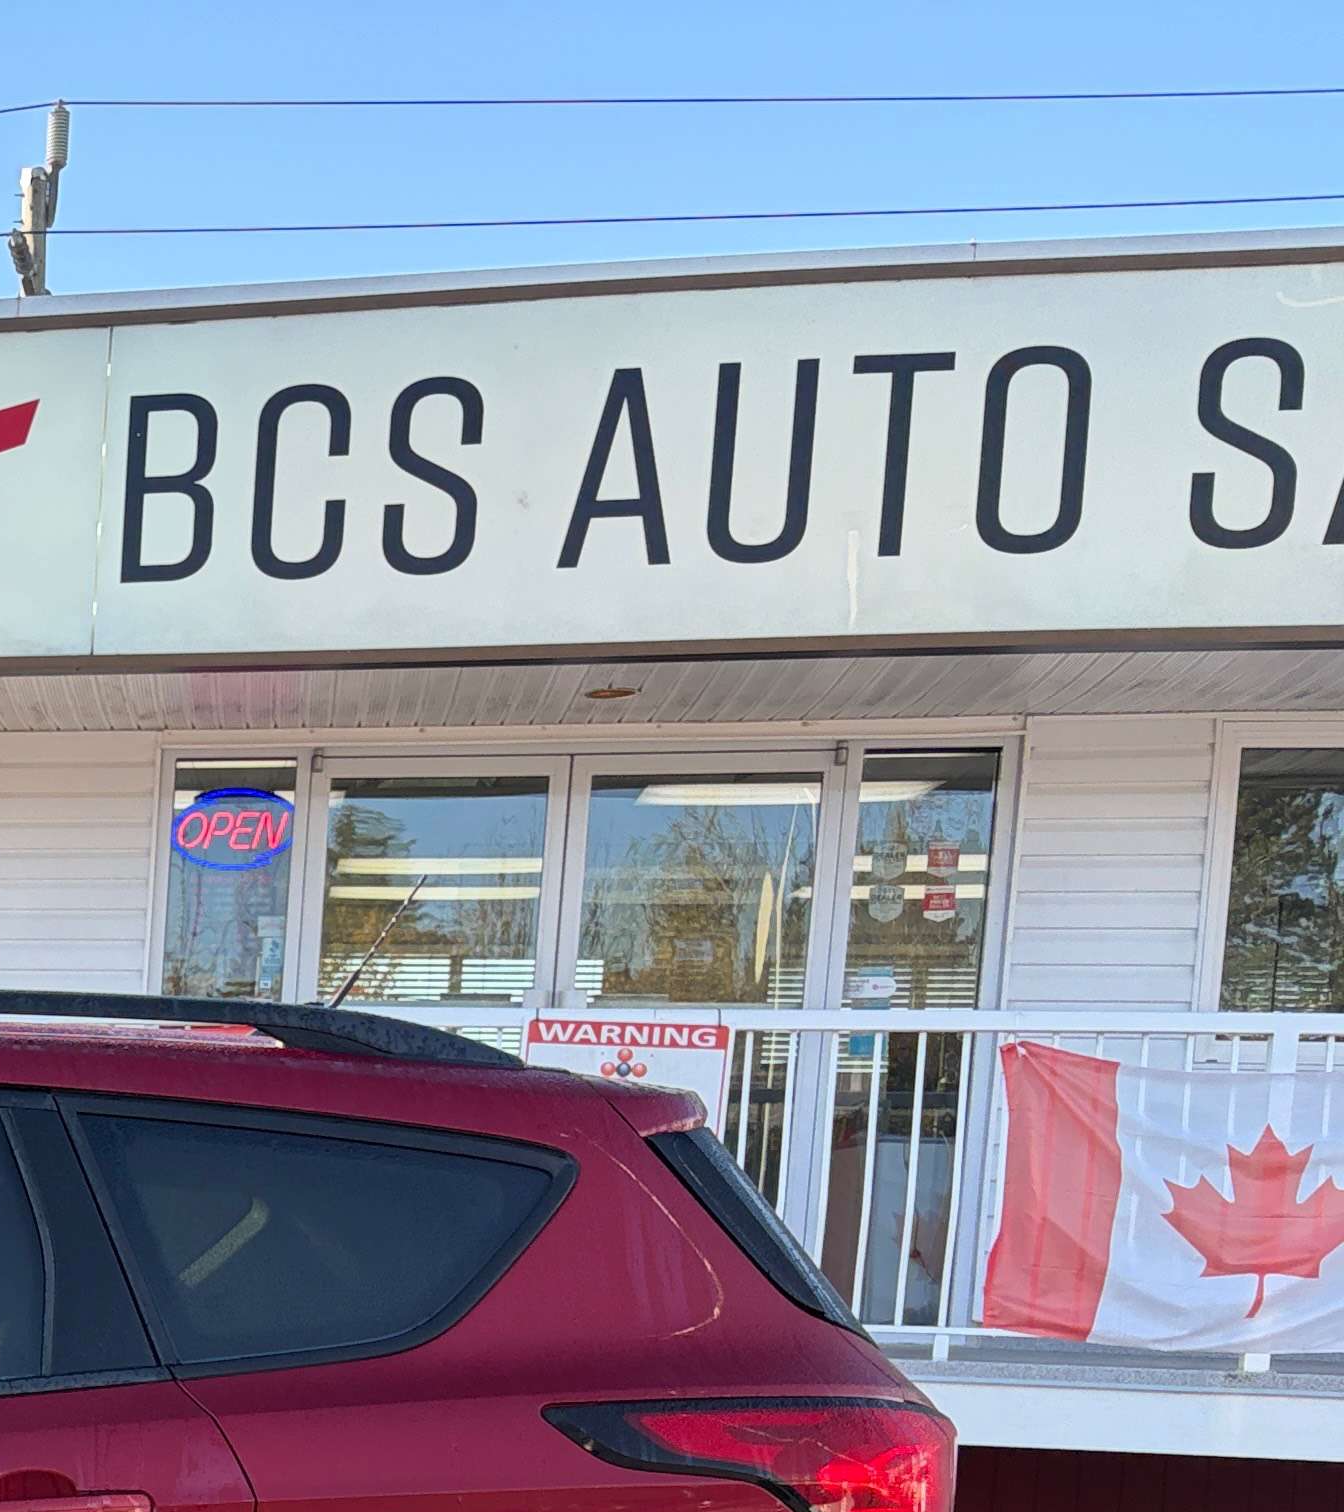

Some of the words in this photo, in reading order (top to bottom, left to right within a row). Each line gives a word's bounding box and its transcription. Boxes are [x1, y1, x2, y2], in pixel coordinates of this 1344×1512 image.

[119, 375, 485, 583] BCS
[556, 345, 1093, 568] AUTO
[1188, 337, 1344, 549] S
[176, 811, 290, 850] OPEN
[538, 1022, 718, 1047] WARNING
